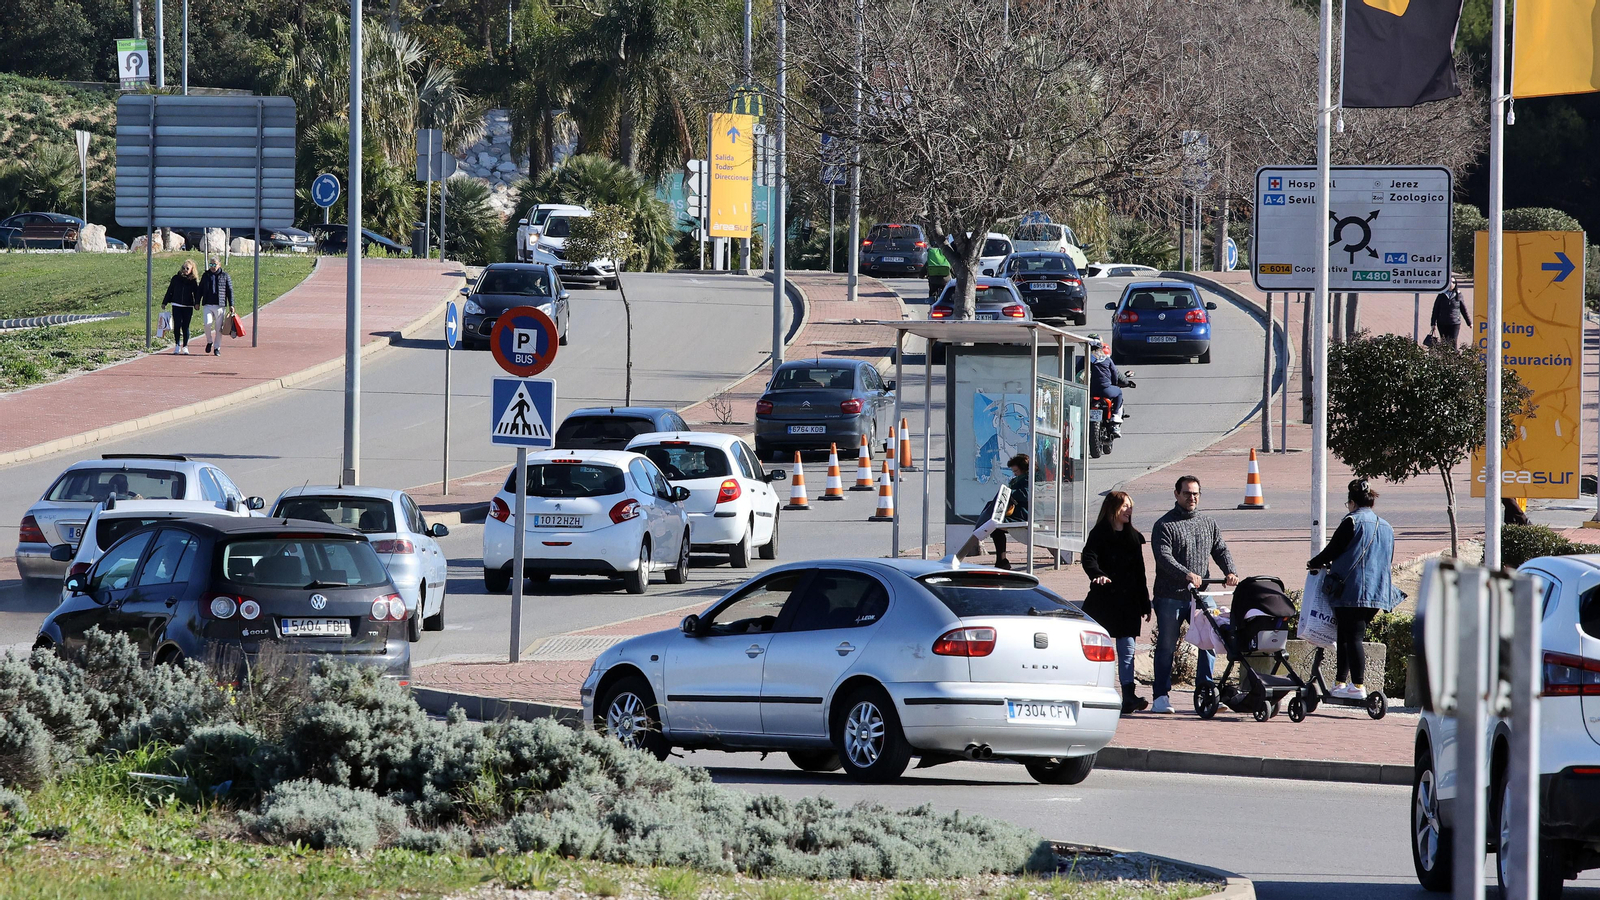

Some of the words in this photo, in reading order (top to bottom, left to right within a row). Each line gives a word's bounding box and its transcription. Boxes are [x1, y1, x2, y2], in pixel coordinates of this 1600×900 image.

[715, 173, 749, 181] Direcciones
[1288, 180, 1336, 190] Hospl
[1390, 180, 1418, 188] Jerez
[1265, 195, 1284, 204] A-4
[1390, 193, 1444, 203] Zoologico
[1354, 272, 1388, 280] A-480
[1392, 268, 1442, 277] Sanlucar
[1479, 322, 1535, 337] Pking
[517, 333, 530, 349] P
[515, 354, 533, 364] BUS
[292, 620, 321, 632] 5404
[326, 620, 347, 632] FBH
[1016, 704, 1046, 718] 7304
[1049, 705, 1071, 719] CFV
